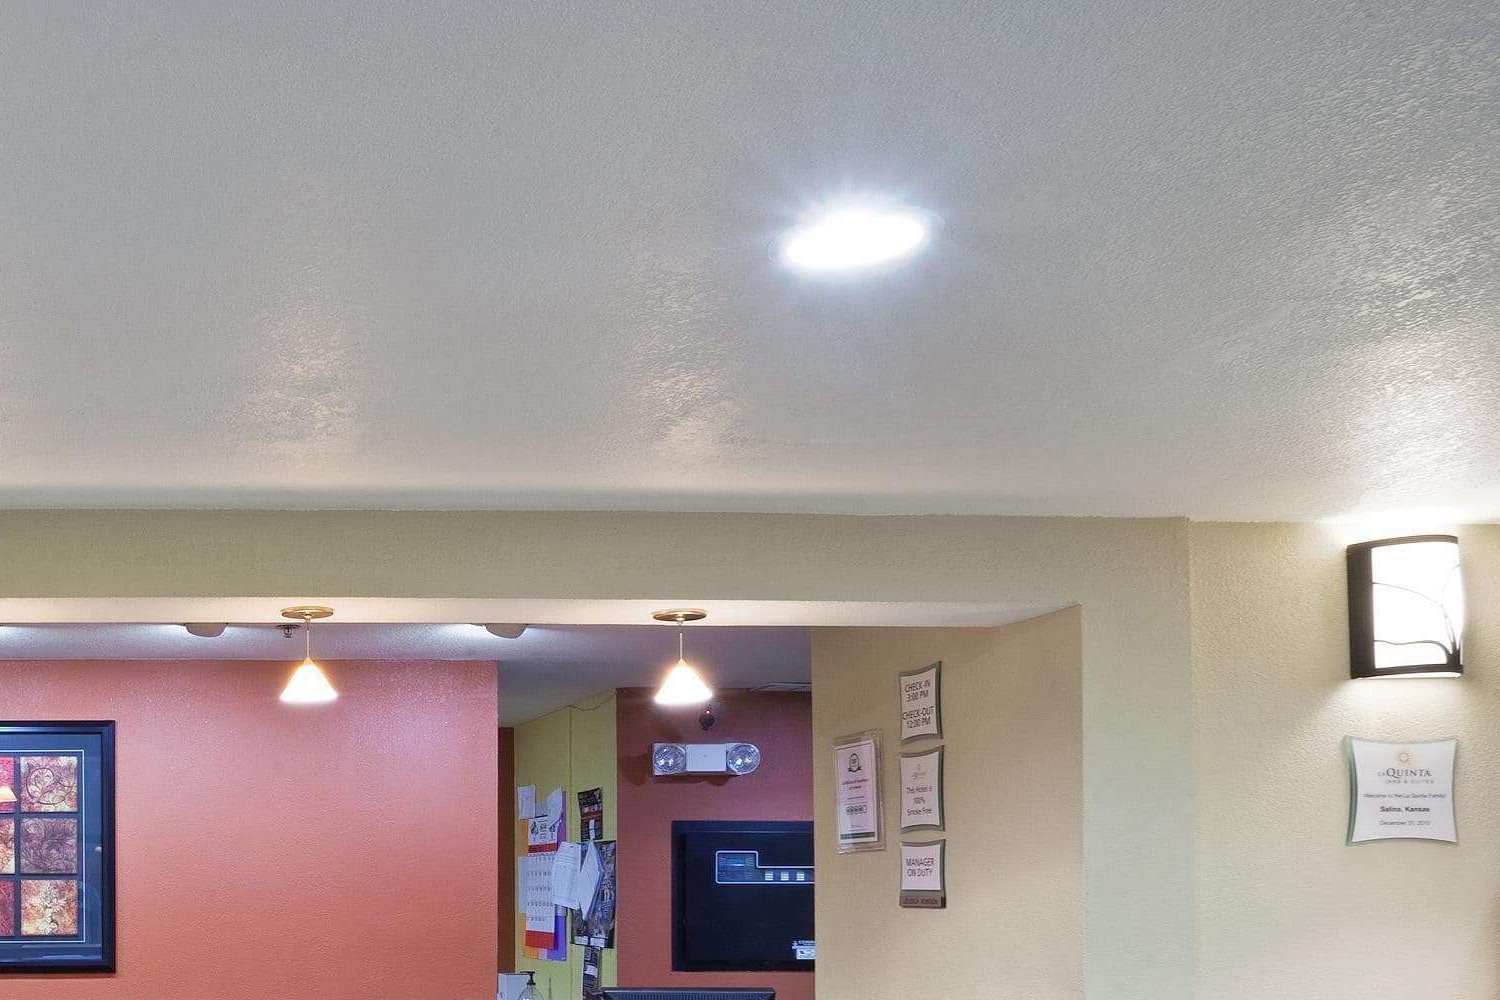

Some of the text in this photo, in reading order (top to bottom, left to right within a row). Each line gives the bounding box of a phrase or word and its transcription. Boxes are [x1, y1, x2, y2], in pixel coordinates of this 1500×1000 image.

[904, 680, 931, 693] CHECK-IN
[920, 689, 929, 698] PM
[901, 705, 935, 721] CHECK-OUT
[921, 716, 931, 726] PM
[1386, 767, 1432, 779] QUINTA
[906, 856, 935, 867] MANAGER
[907, 867, 932, 877] ON DUTY
